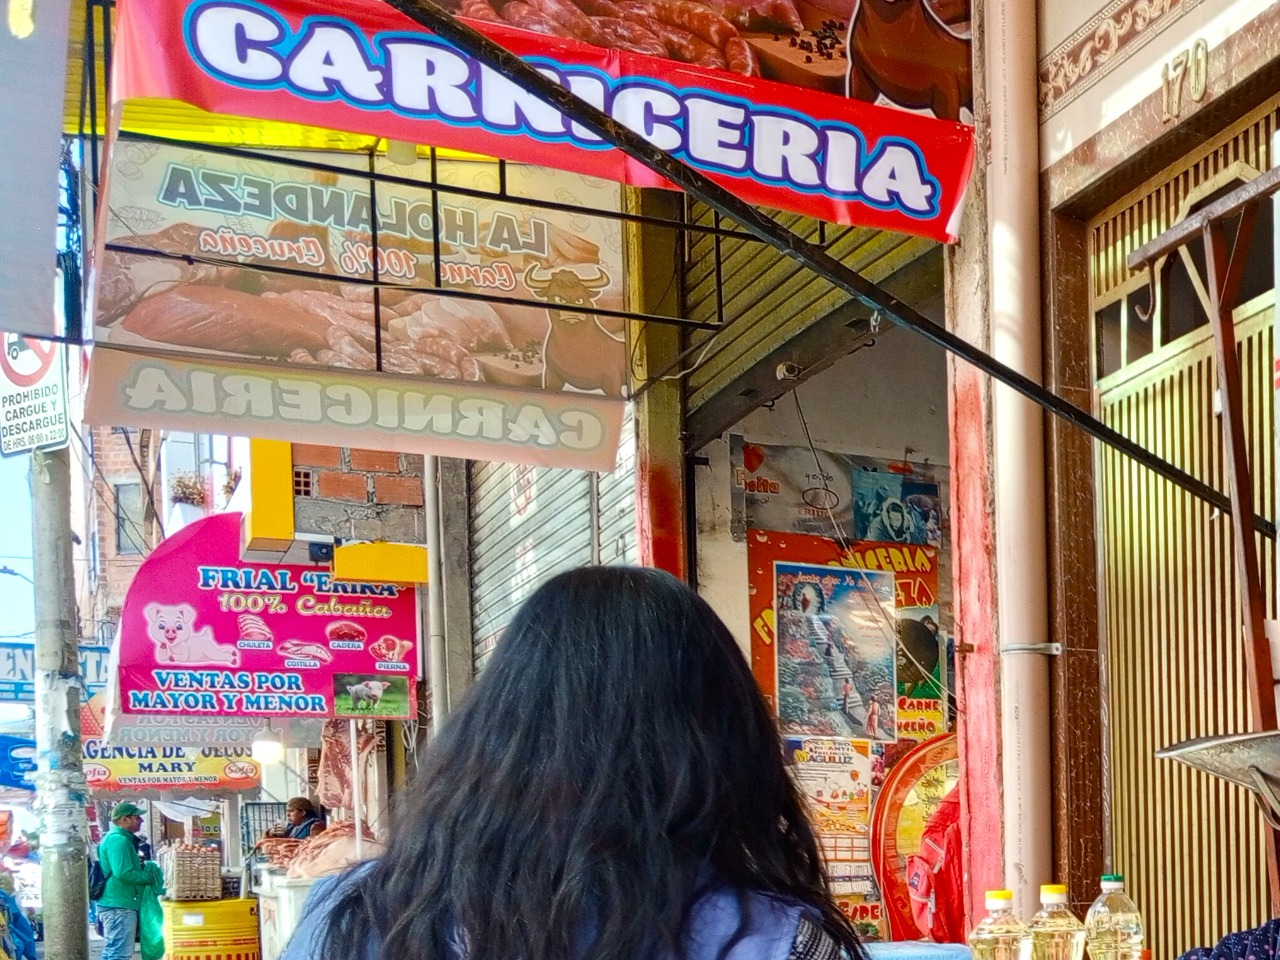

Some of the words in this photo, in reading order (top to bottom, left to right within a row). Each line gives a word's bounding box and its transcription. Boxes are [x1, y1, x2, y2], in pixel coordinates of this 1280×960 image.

[1161, 38, 1209, 124] 170
[190, 3, 938, 214] CARNICERIA
[2, 384, 59, 408] PROHIBIDO
[5, 402, 48, 422] CARGUE
[51, 399, 57, 411] Y
[2, 413, 64, 437] DESCARGUE
[3, 440, 12, 451] DE
[198, 566, 297, 593] FRIAL
[218, 593, 288, 614] 100%
[297, 595, 392, 618] Cabaña
[239, 641, 271, 649] CHULETA
[331, 642, 362, 650] CADERA
[286, 660, 319, 668] COSTILLA
[378, 662, 408, 670] PIERNA
[154, 671, 251, 690] VENTAS
[256, 673, 303, 690] POR
[130, 691, 218, 711] MAYOR
[220, 693, 240, 710] Y
[244, 694, 327, 712] MENOR
[138, 762, 197, 773] MARY
[227, 766, 255, 778] Sofía
[118, 776, 145, 784] VENTAS
[147, 776, 161, 784] POR
[162, 776, 186, 784] MAYOR
[194, 775, 219, 783] MENOR
